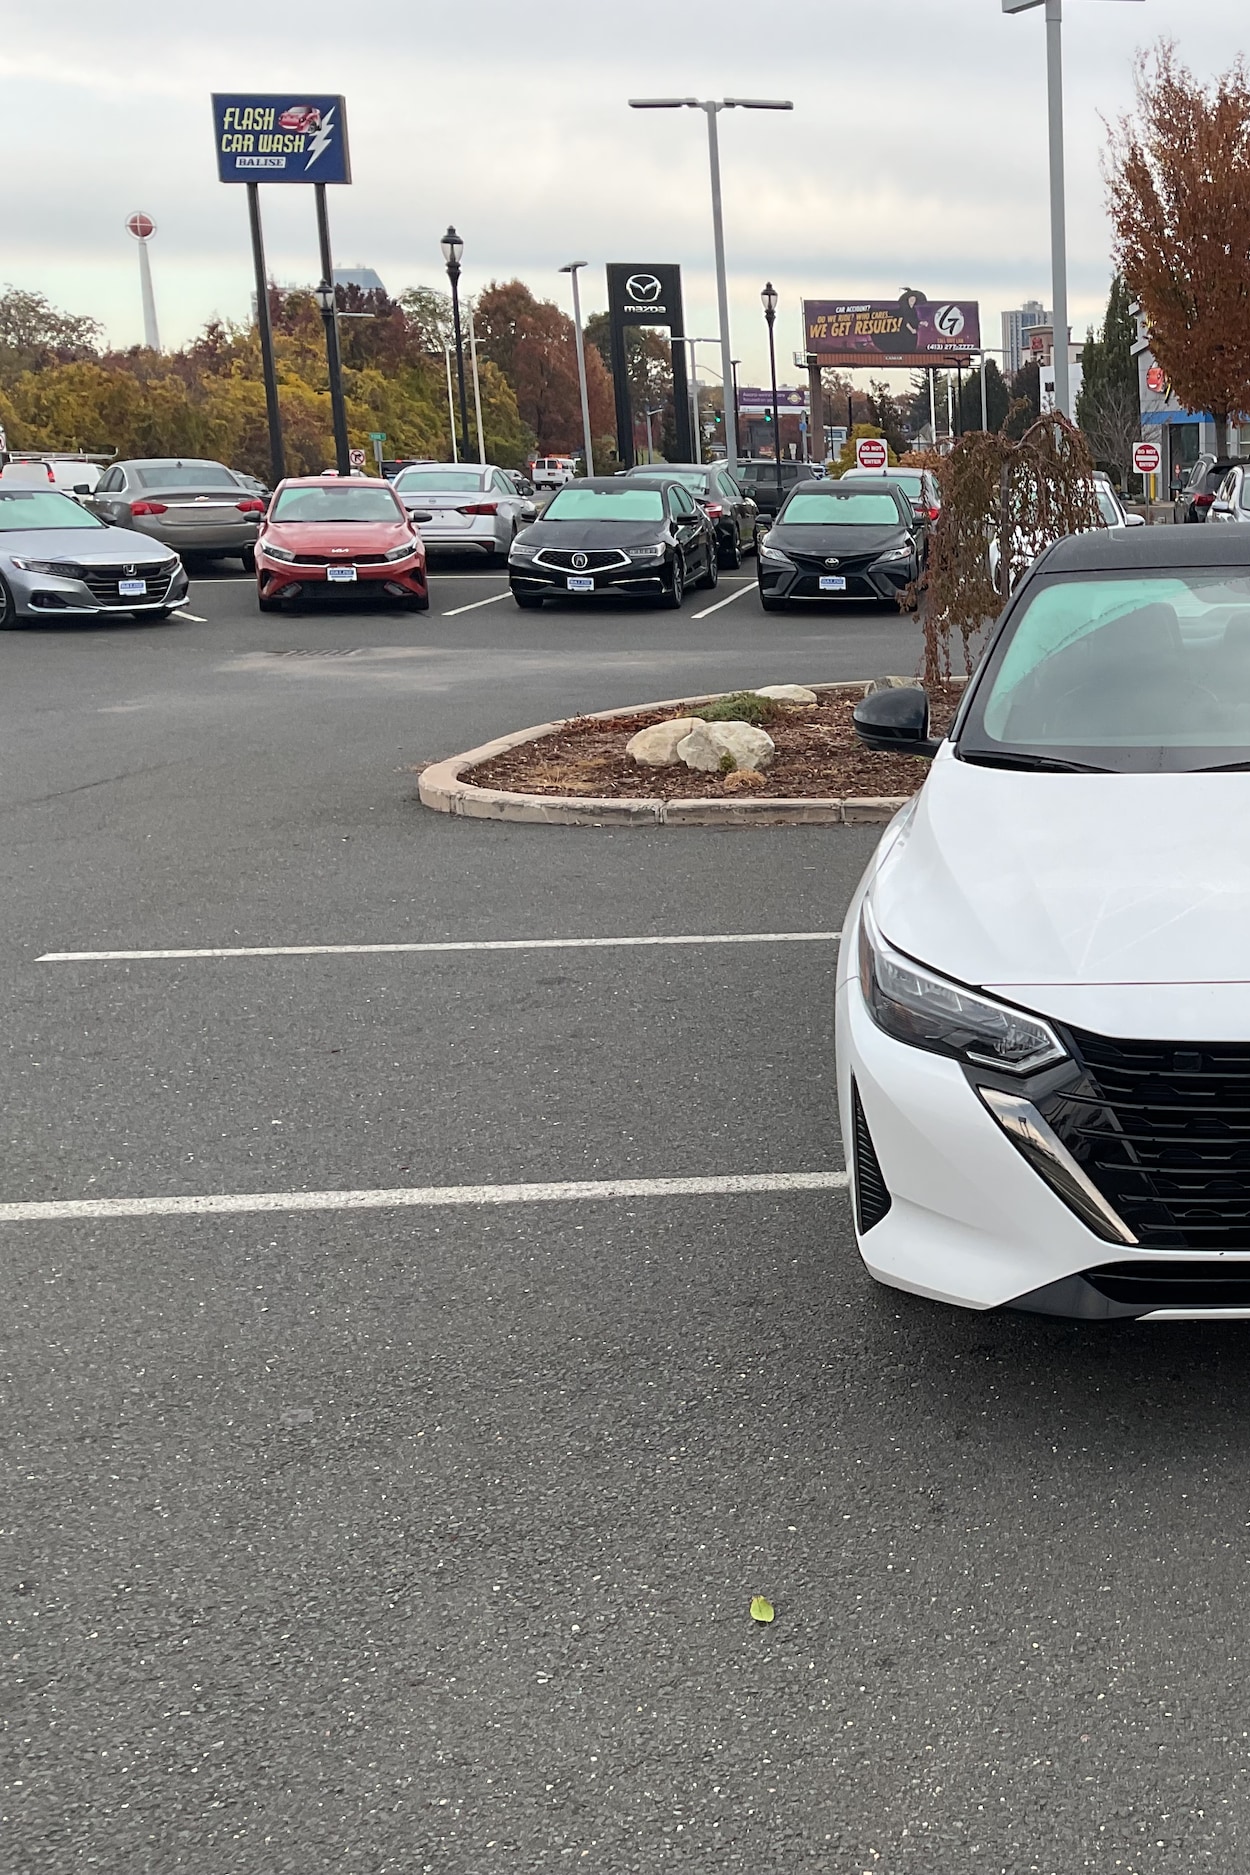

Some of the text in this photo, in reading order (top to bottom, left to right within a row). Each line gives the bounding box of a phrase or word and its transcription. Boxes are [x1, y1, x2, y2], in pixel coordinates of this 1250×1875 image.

[223, 107, 276, 131] FLASH
[221, 134, 306, 153] CAR WASH
[237, 157, 285, 167] BALISE
[817, 315, 826, 323] DO
[828, 314, 836, 322] WE
[856, 312, 870, 320] WHO
[809, 317, 903, 339] WE GET RESULTS!
